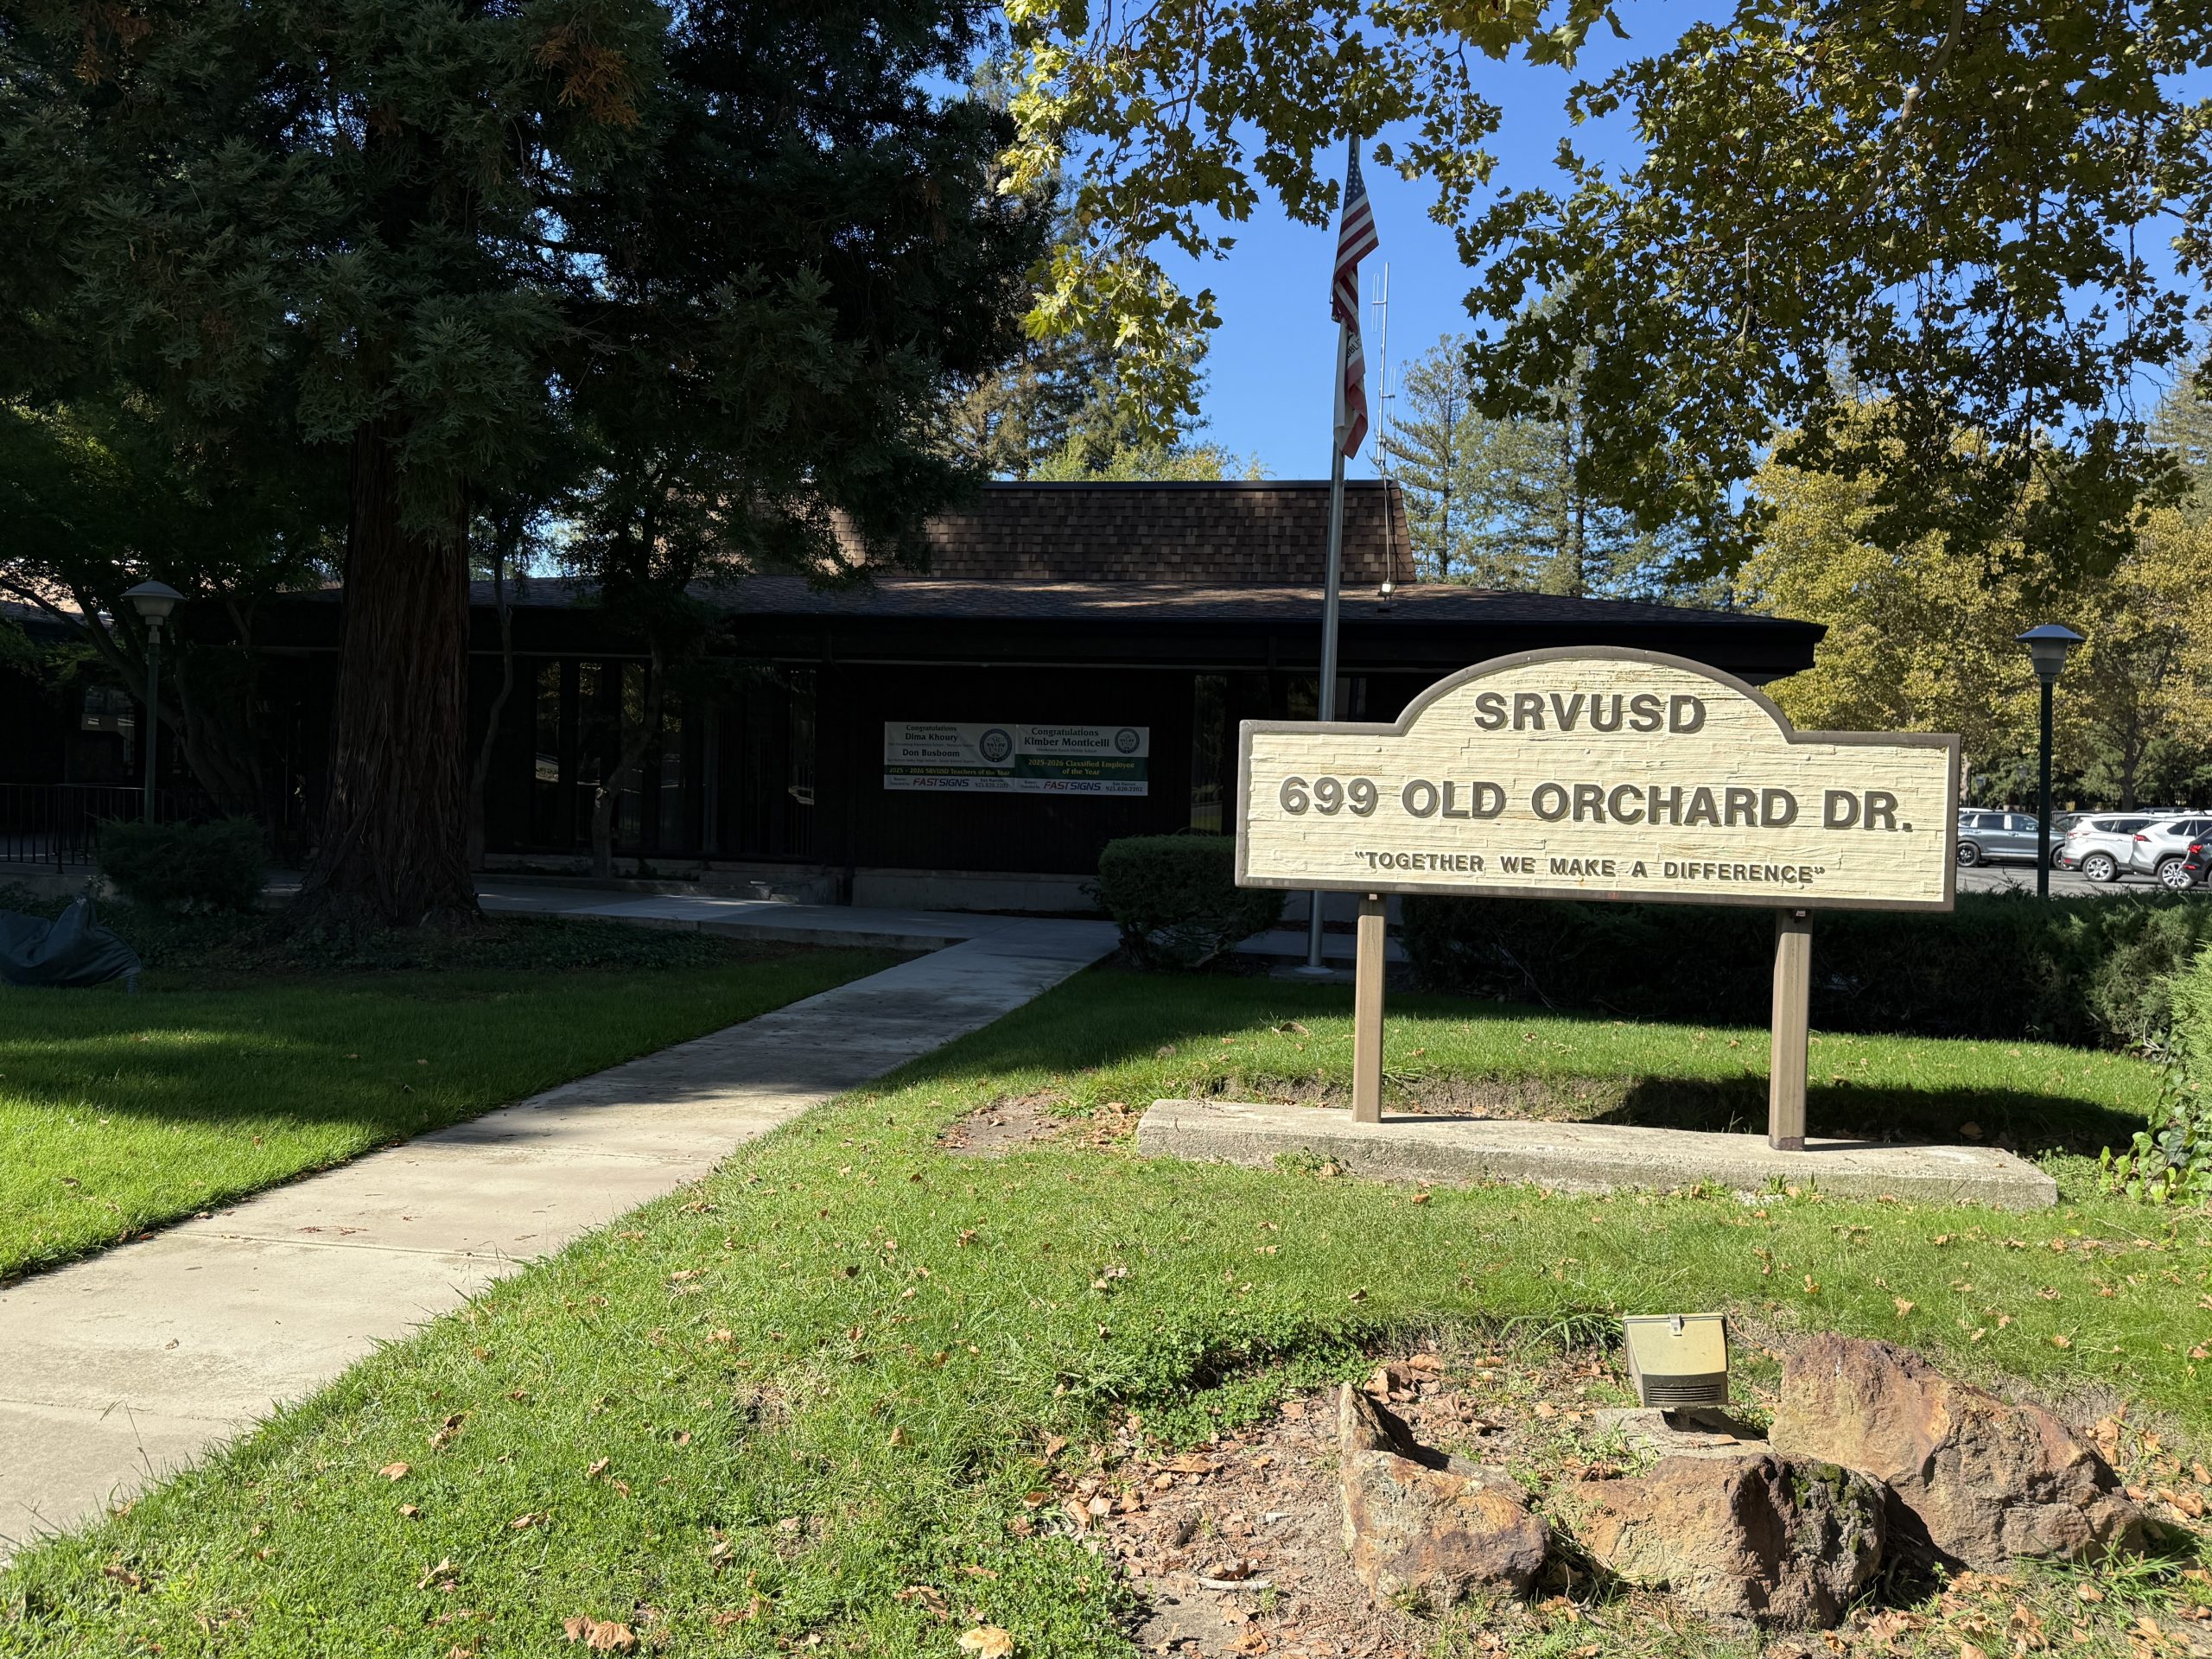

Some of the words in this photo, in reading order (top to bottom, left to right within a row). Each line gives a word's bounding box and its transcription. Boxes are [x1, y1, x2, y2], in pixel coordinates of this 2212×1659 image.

[1474, 691, 1707, 734] SRVUSD
[1031, 727, 1099, 737] Congratulations
[929, 733, 958, 742] Khoury
[1024, 737, 1058, 746] Kimber
[1062, 738, 1109, 747] Monticelli
[1102, 760, 1135, 769] Employee
[912, 778, 969, 788] FASTSIGNS
[1044, 780, 1102, 791] FASTSIGNS
[1280, 777, 1378, 817] 699
[1402, 779, 1506, 820] OLD
[1532, 782, 1798, 827] ORCHARD
[1824, 790, 1912, 831] DR.
[1501, 855, 1536, 875] WE
[1550, 857, 1615, 878] MAKE
[1631, 861, 1648, 878] A
